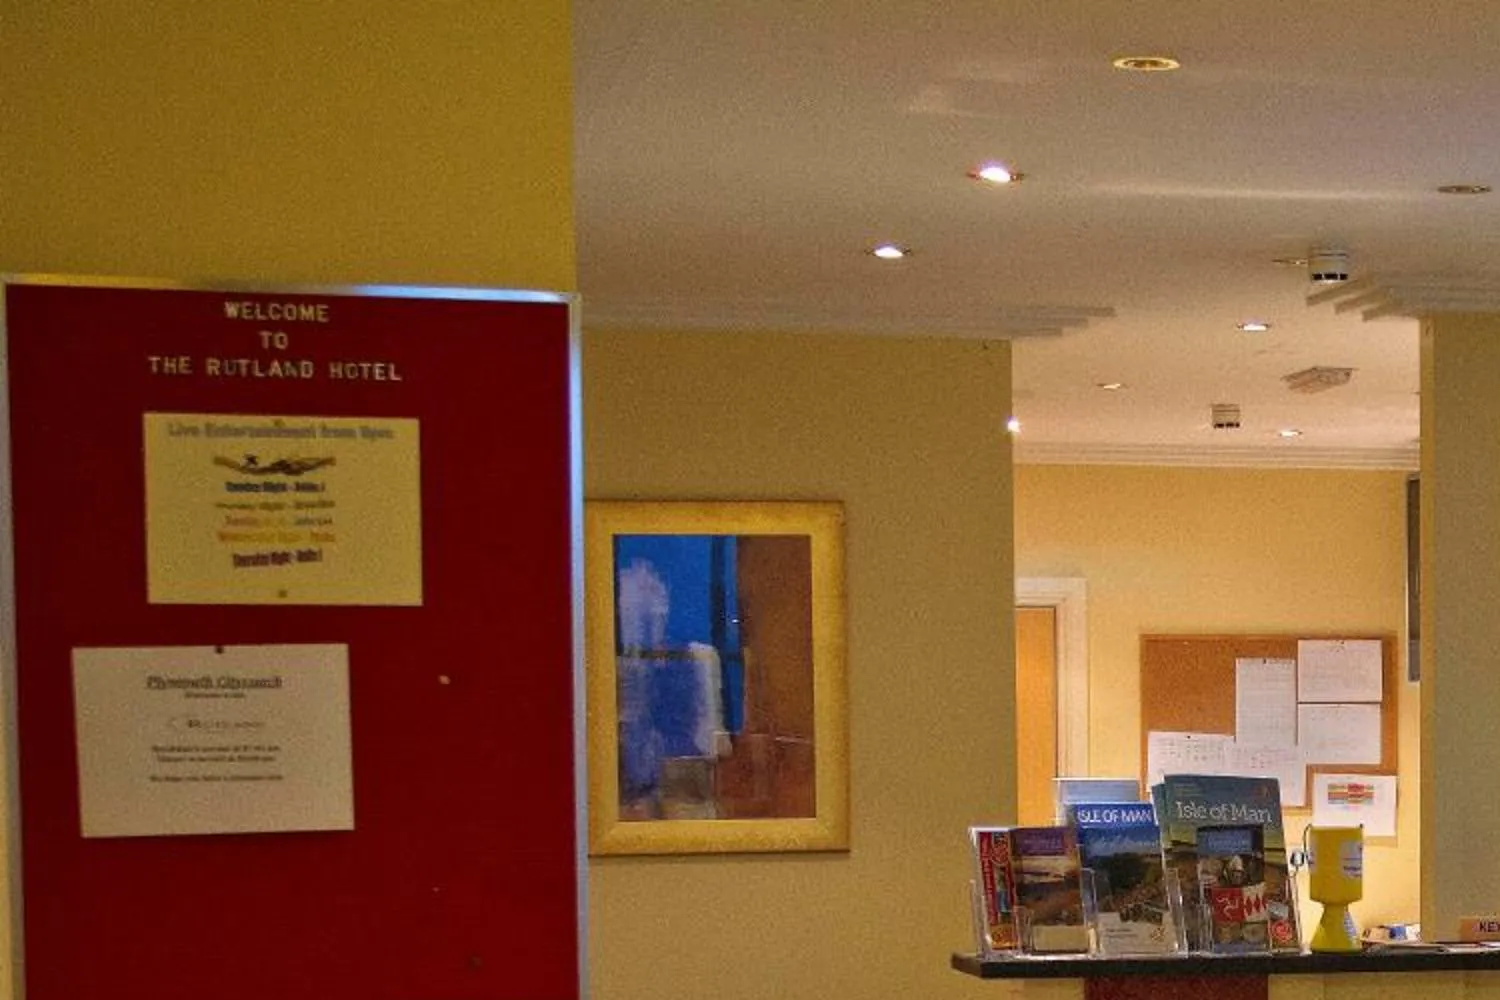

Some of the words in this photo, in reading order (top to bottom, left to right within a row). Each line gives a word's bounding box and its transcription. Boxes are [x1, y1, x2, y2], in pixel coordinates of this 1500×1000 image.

[224, 301, 330, 322] WELCOME
[259, 331, 289, 350] TO
[148, 356, 193, 375] THE
[206, 358, 314, 379] RUTLAND
[329, 362, 403, 381] HOTEL
[1077, 809, 1101, 823] ISLE
[1102, 809, 1119, 823] OF
[1121, 809, 1153, 823] MAN
[1175, 801, 1207, 820] Isle
[1209, 802, 1229, 820] of
[1229, 803, 1274, 824] Man
